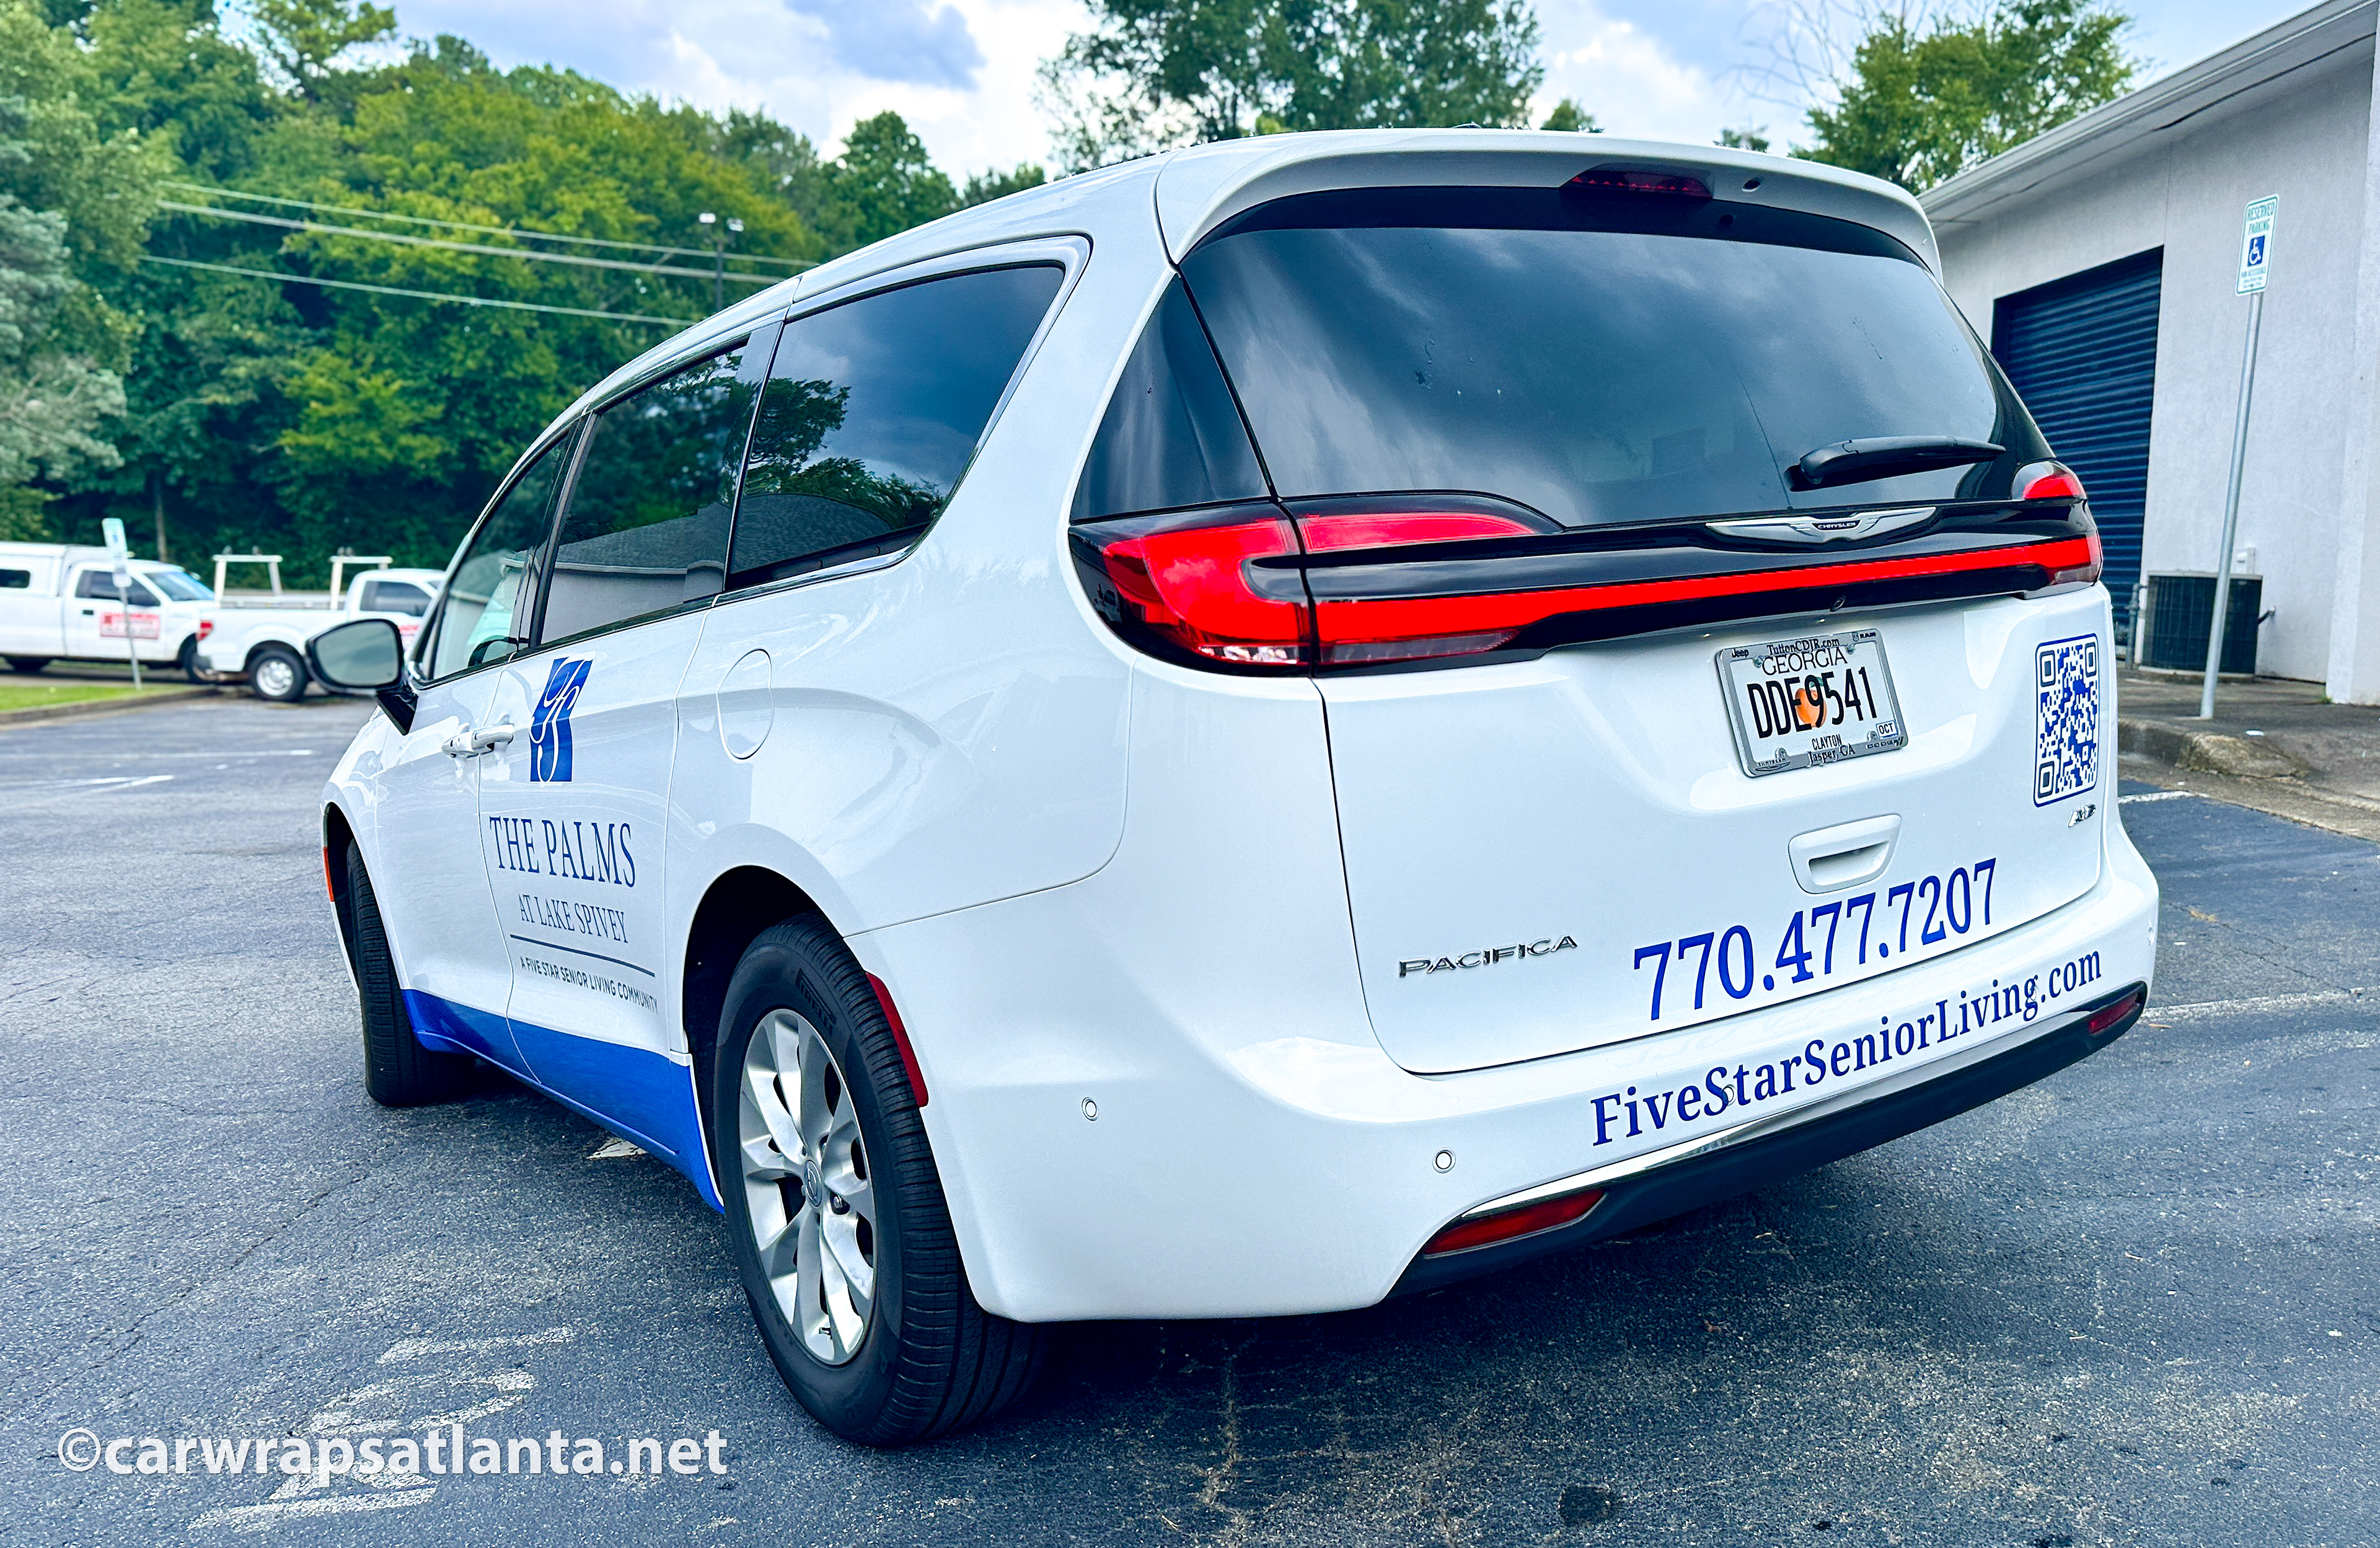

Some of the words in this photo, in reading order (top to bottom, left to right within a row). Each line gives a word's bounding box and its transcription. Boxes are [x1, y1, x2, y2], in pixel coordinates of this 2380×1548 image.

[2247, 201, 2275, 221] RESERVED
[2248, 218, 2270, 234] PARKING
[1731, 648, 1749, 658] Jeep
[1762, 646, 1848, 675] GEORGIA
[1766, 638, 1840, 656] TuttonCDJR.com
[1747, 667, 1877, 739] DDE9541
[1812, 733, 1842, 750] CLAYTON
[1879, 722, 1893, 734] OCT
[1807, 750, 1839, 765] Jasper,
[489, 815, 540, 874] THE
[541, 819, 636, 888] PALMS
[518, 893, 535, 923] AT
[534, 896, 575, 931] LAKE
[574, 902, 628, 944] SPIVEY
[1634, 858, 1996, 1021] 770.477.7207
[1398, 935, 1578, 978] PACIFICA
[520, 956, 527, 970] A
[526, 957, 542, 975] FIVE
[541, 961, 560, 980] STAR
[560, 966, 589, 988] SENIOR
[588, 974, 617, 996] LIVING
[617, 981, 658, 1014] COMMUNITY
[1590, 949, 2102, 1147] FiveStarSeniorLiving.com
